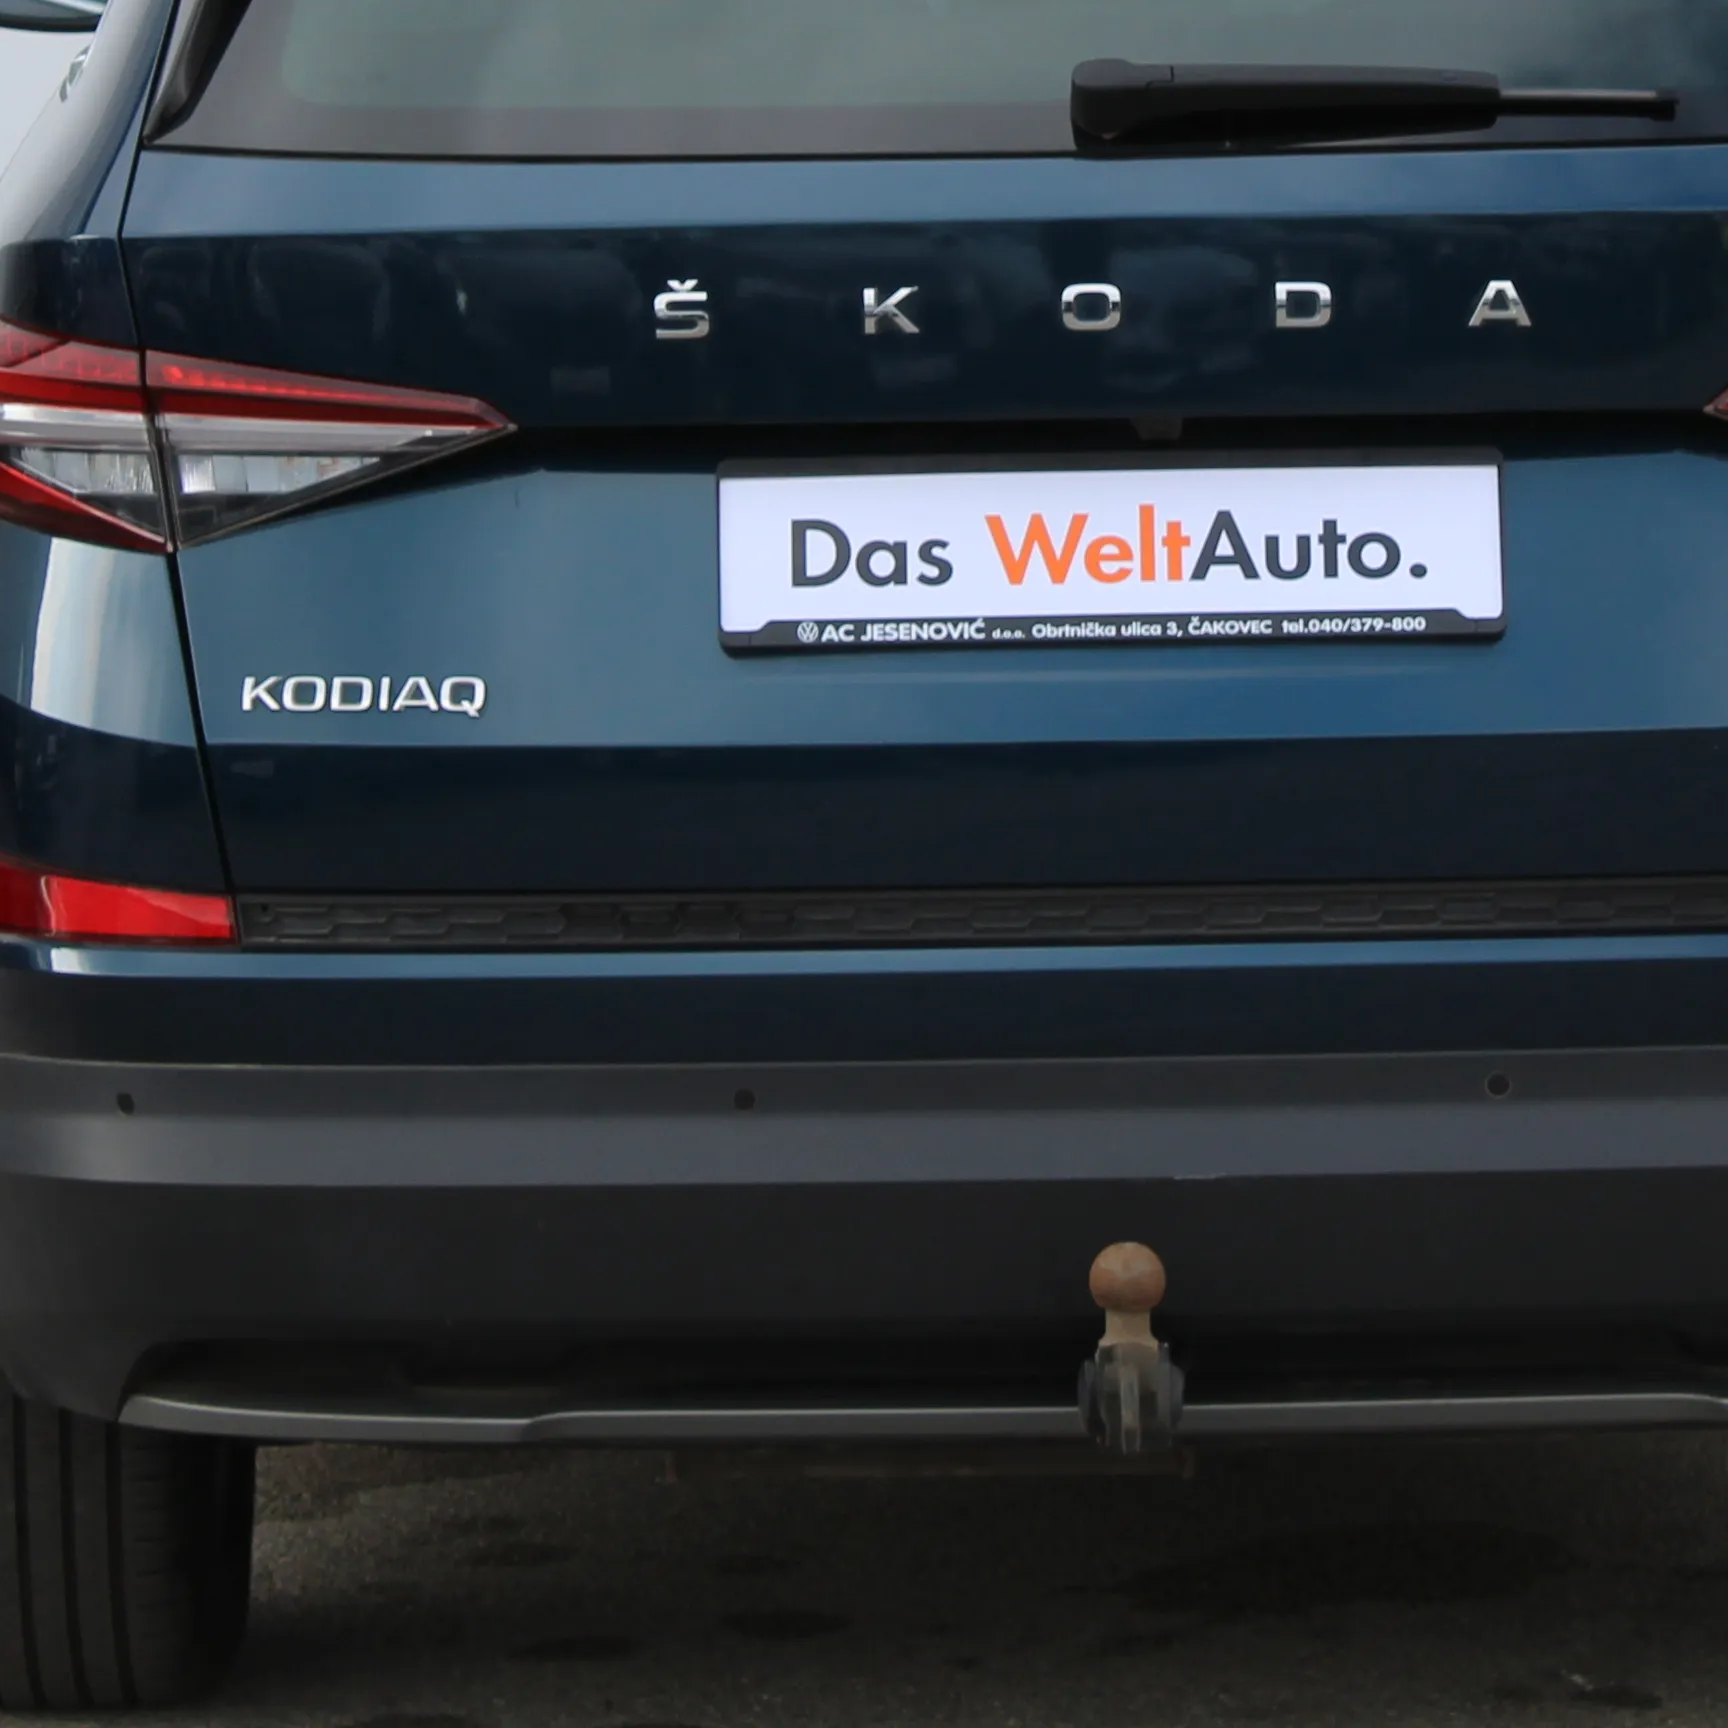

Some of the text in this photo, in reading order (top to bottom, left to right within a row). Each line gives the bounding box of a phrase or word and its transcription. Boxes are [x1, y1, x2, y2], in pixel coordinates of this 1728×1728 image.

[652, 278, 1532, 339] ŠKODA
[790, 503, 1429, 589] Das WeltAuto.
[821, 622, 855, 643] AC
[860, 617, 986, 643] JESENOVIĆ
[1031, 621, 1116, 639] Obrtnička
[1121, 620, 1162, 637] ulica
[1166, 621, 1183, 638] 3,
[1188, 616, 1273, 636] ČAKOVEC
[1282, 615, 1427, 634] tel.040/379-800
[240, 675, 486, 718] KODIAQ
